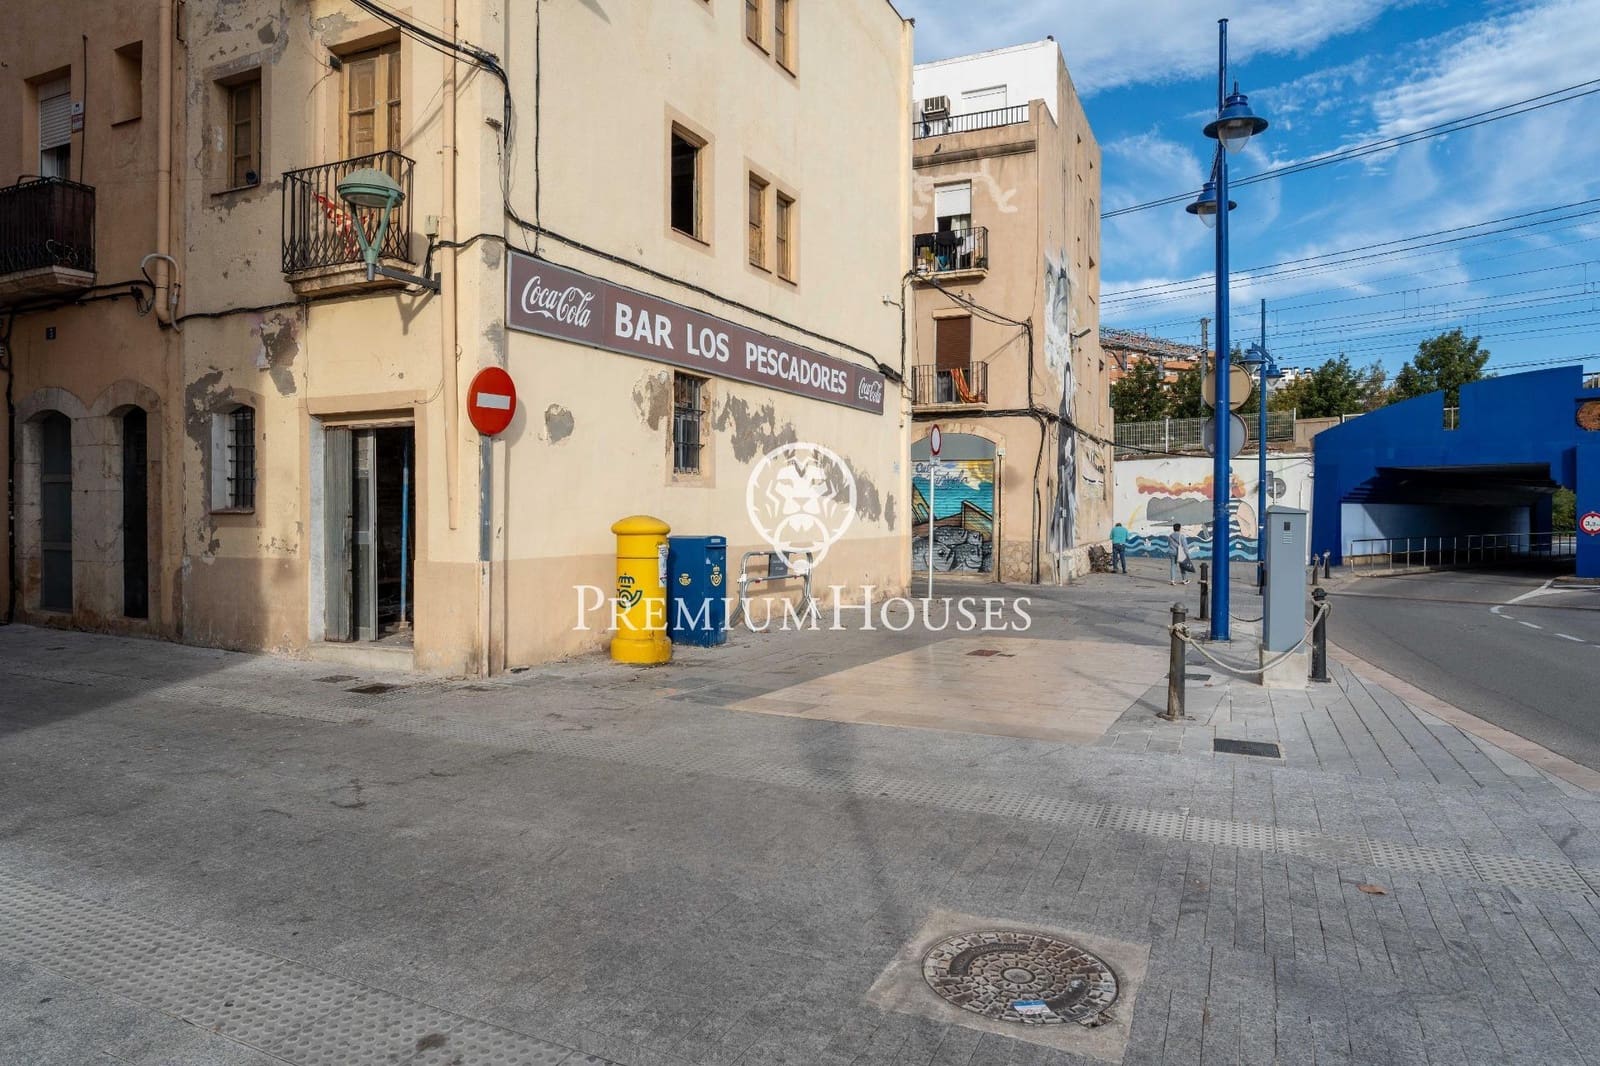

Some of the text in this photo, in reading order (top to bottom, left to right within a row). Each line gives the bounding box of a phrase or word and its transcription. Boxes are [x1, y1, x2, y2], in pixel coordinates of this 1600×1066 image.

[521, 275, 595, 328] Coca-Cola
[615, 302, 847, 395] BAR LOS PESCADORES
